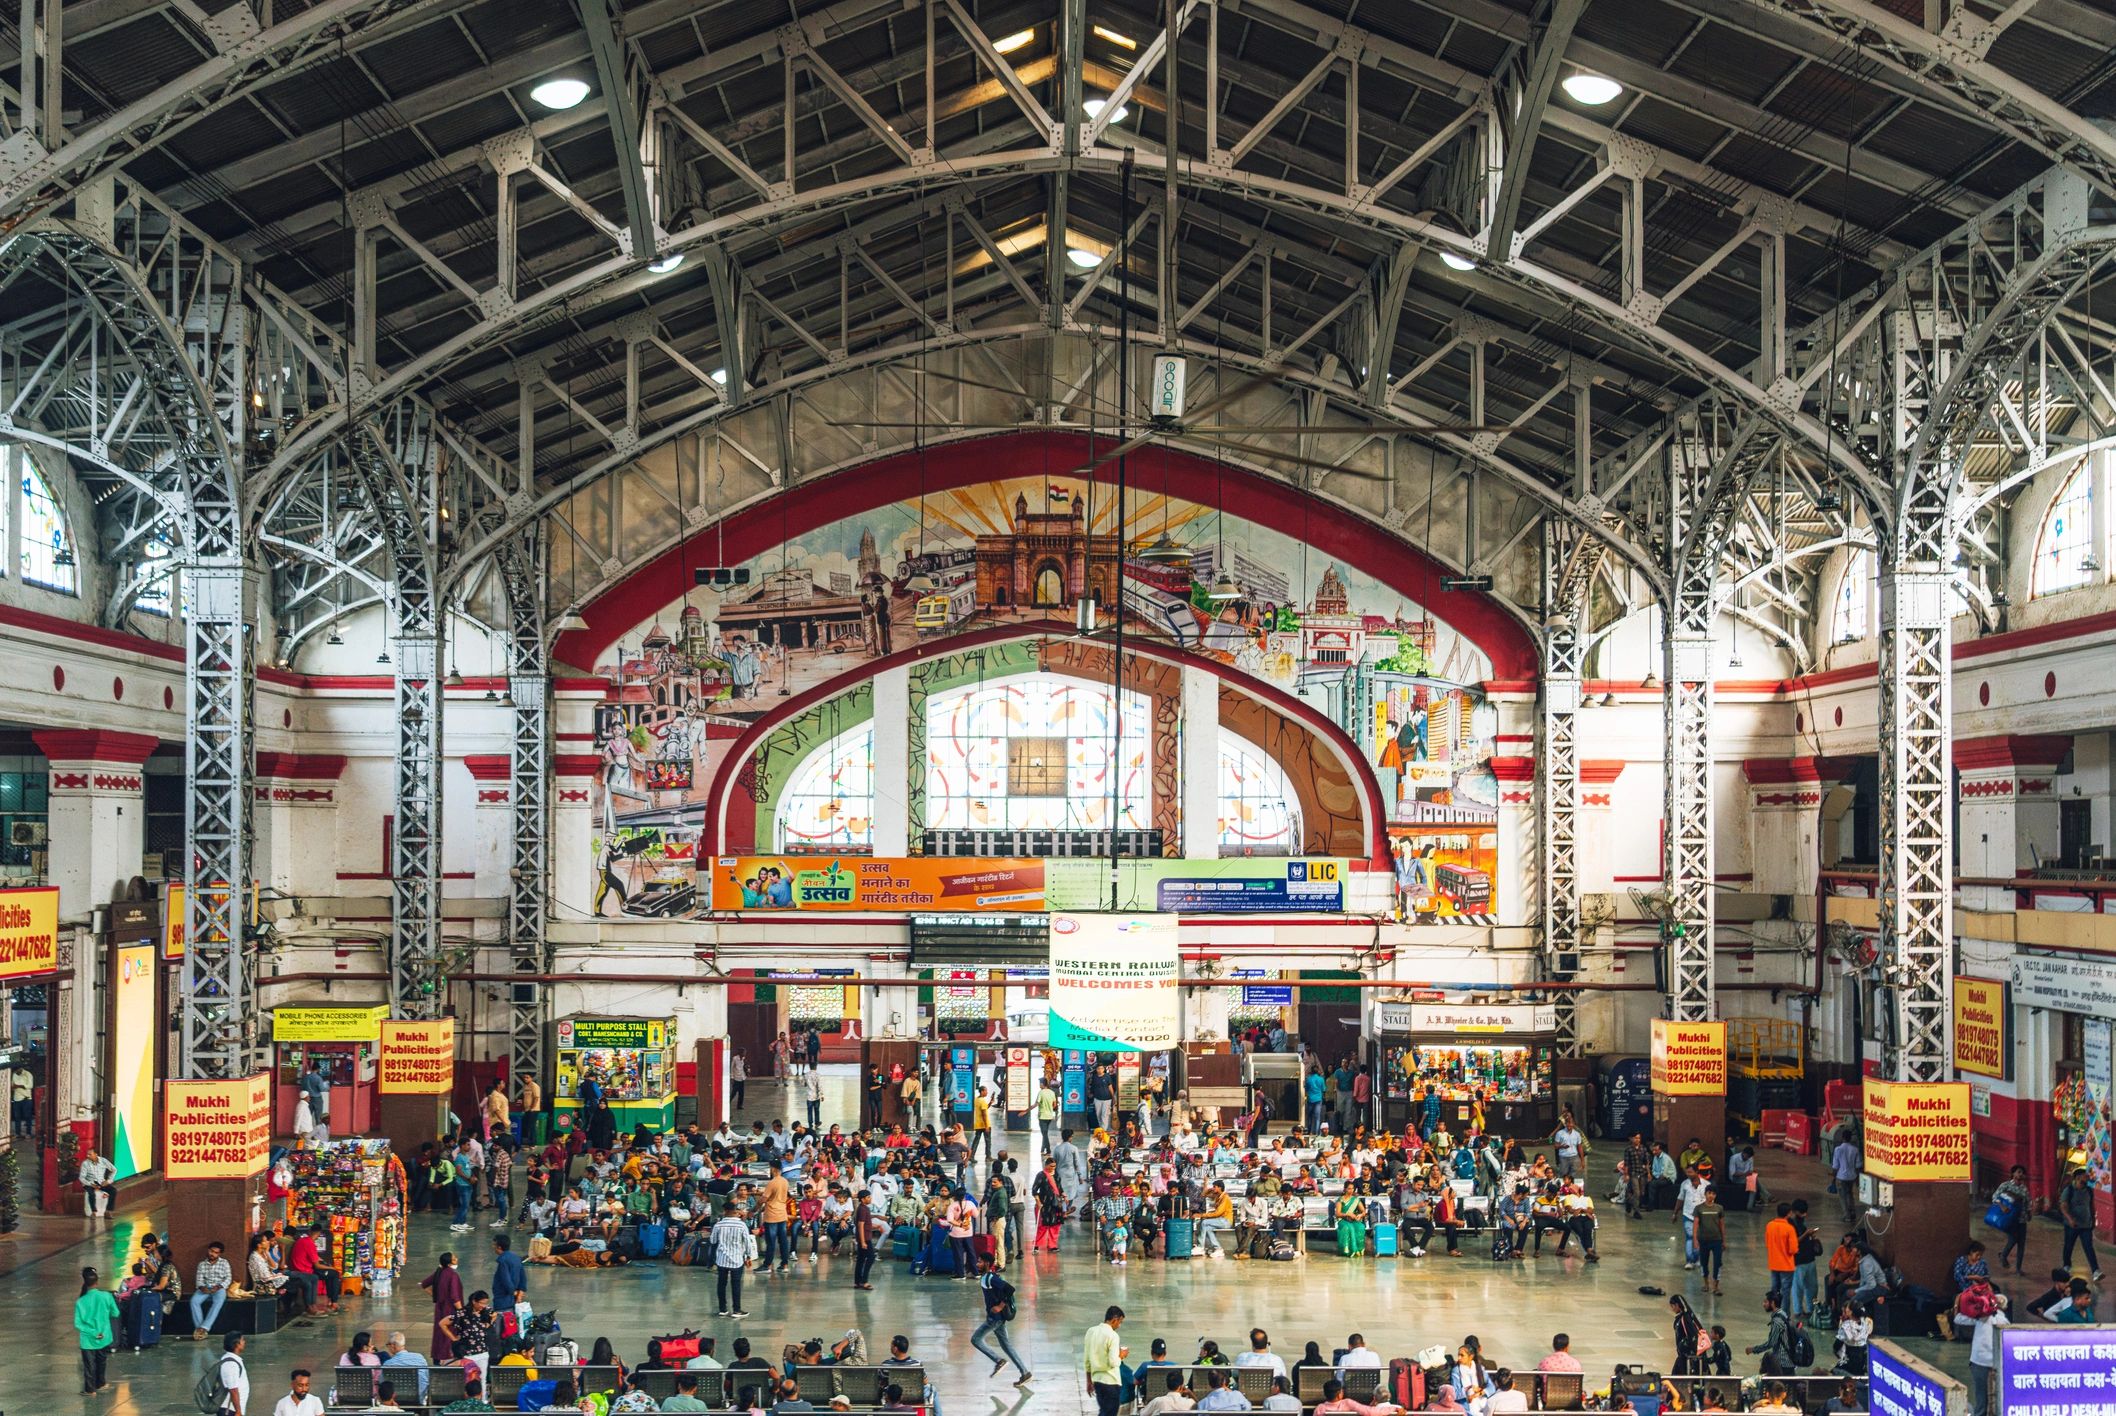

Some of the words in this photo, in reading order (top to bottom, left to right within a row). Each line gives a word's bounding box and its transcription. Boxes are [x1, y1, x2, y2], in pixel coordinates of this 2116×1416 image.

[1163, 361, 1176, 411] ecoair
[861, 863, 889, 873] उत्सव
[1310, 863, 1335, 880] LIC
[861, 876, 893, 888] मनाने
[895, 878, 910, 888] का
[801, 887, 851, 901] उत्सव
[861, 890, 898, 904] गारंटीड
[900, 891, 934, 904] तरीका
[1055, 959, 1121, 970] WESTERN
[1055, 968, 1093, 976] MUMBAI
[1057, 978, 1154, 989] WELCOMES
[1159, 978, 1177, 988] YOU
[1384, 1015, 1410, 1025] STALL
[1535, 1016, 1555, 1025] STALL
[575, 1022, 595, 1030] MULTI
[596, 1022, 627, 1031] PURPOSE
[628, 1022, 648, 1031] STALL
[396, 1032, 429, 1041] Mukhi
[1125, 1034, 1170, 1042] 41020
[1678, 1033, 1710, 1042] Mukhi
[1957, 1022, 1999, 1048] 9819748075
[383, 1044, 441, 1054] Publicities
[1666, 1045, 1722, 1055] Publicities
[385, 1059, 441, 1070] 9819748075
[1667, 1060, 1722, 1071] 9819748075
[384, 1072, 441, 1083] 9221447682
[1667, 1072, 1722, 1083] 9221447682
[186, 1096, 230, 1108] Mukhi
[1907, 1098, 1951, 1110] Mukhi
[169, 1113, 247, 1125] Publicities
[1891, 1115, 1968, 1127] Publicities
[171, 1131, 247, 1146] 9819748075
[1893, 1134, 1968, 1148] 9819748075
[171, 1148, 247, 1163] 9221447682
[1893, 1151, 1968, 1166] 9221447682
[2013, 1345, 2041, 1361] बाल
[2042, 1344, 2091, 1362] सहायता
[2013, 1373, 2038, 1389] बाल
[2039, 1373, 2082, 1390] सहायता
[2007, 1404, 2040, 1416] CHILD
[2041, 1404, 2070, 1416] HELP
